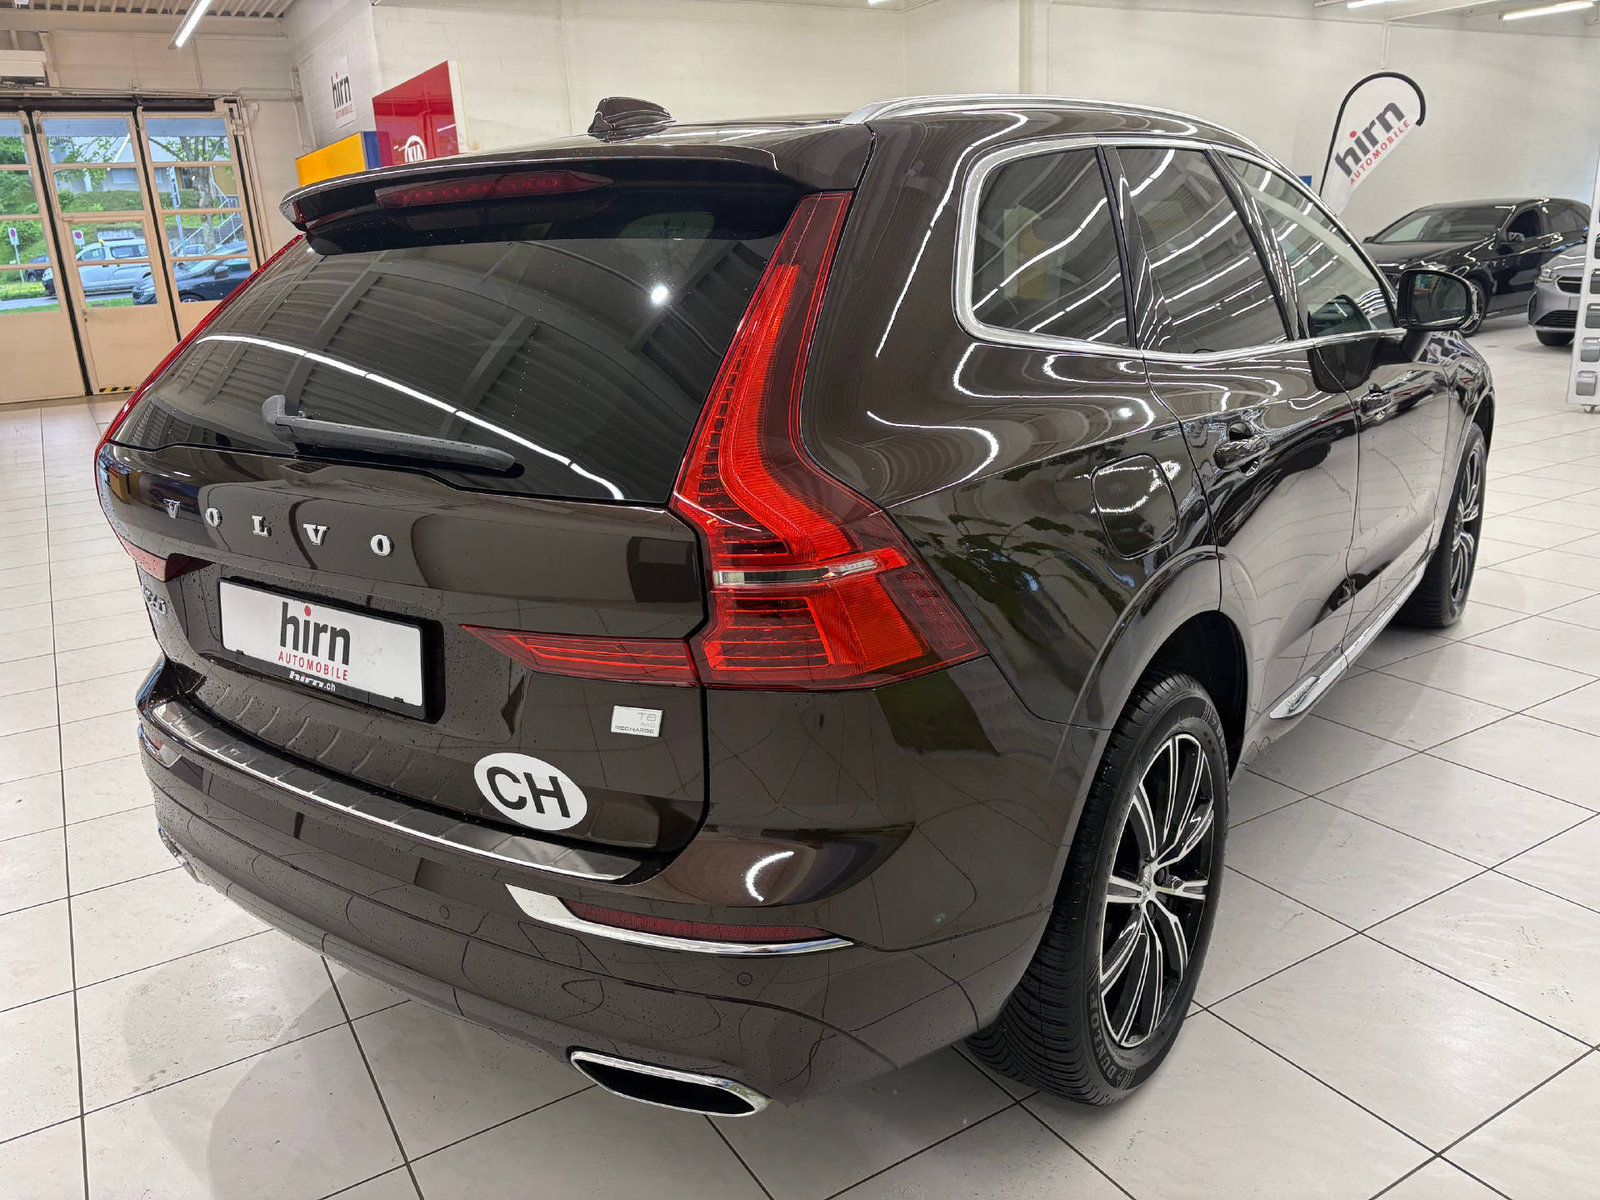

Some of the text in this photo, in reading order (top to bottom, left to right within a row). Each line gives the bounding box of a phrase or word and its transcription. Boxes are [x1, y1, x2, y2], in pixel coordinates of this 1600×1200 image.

[330, 71, 352, 110] hirn
[1334, 102, 1406, 178] hirn
[1350, 119, 1410, 185] AUTOMOBILE
[162, 498, 395, 557] VOLVO
[279, 601, 351, 666] hirn
[278, 651, 349, 681] AUTOMOBILE
[288, 670, 336, 692] hirn.ch
[614, 724, 655, 734] RECHARGE
[637, 711, 657, 722] T8
[486, 766, 571, 819] CH
